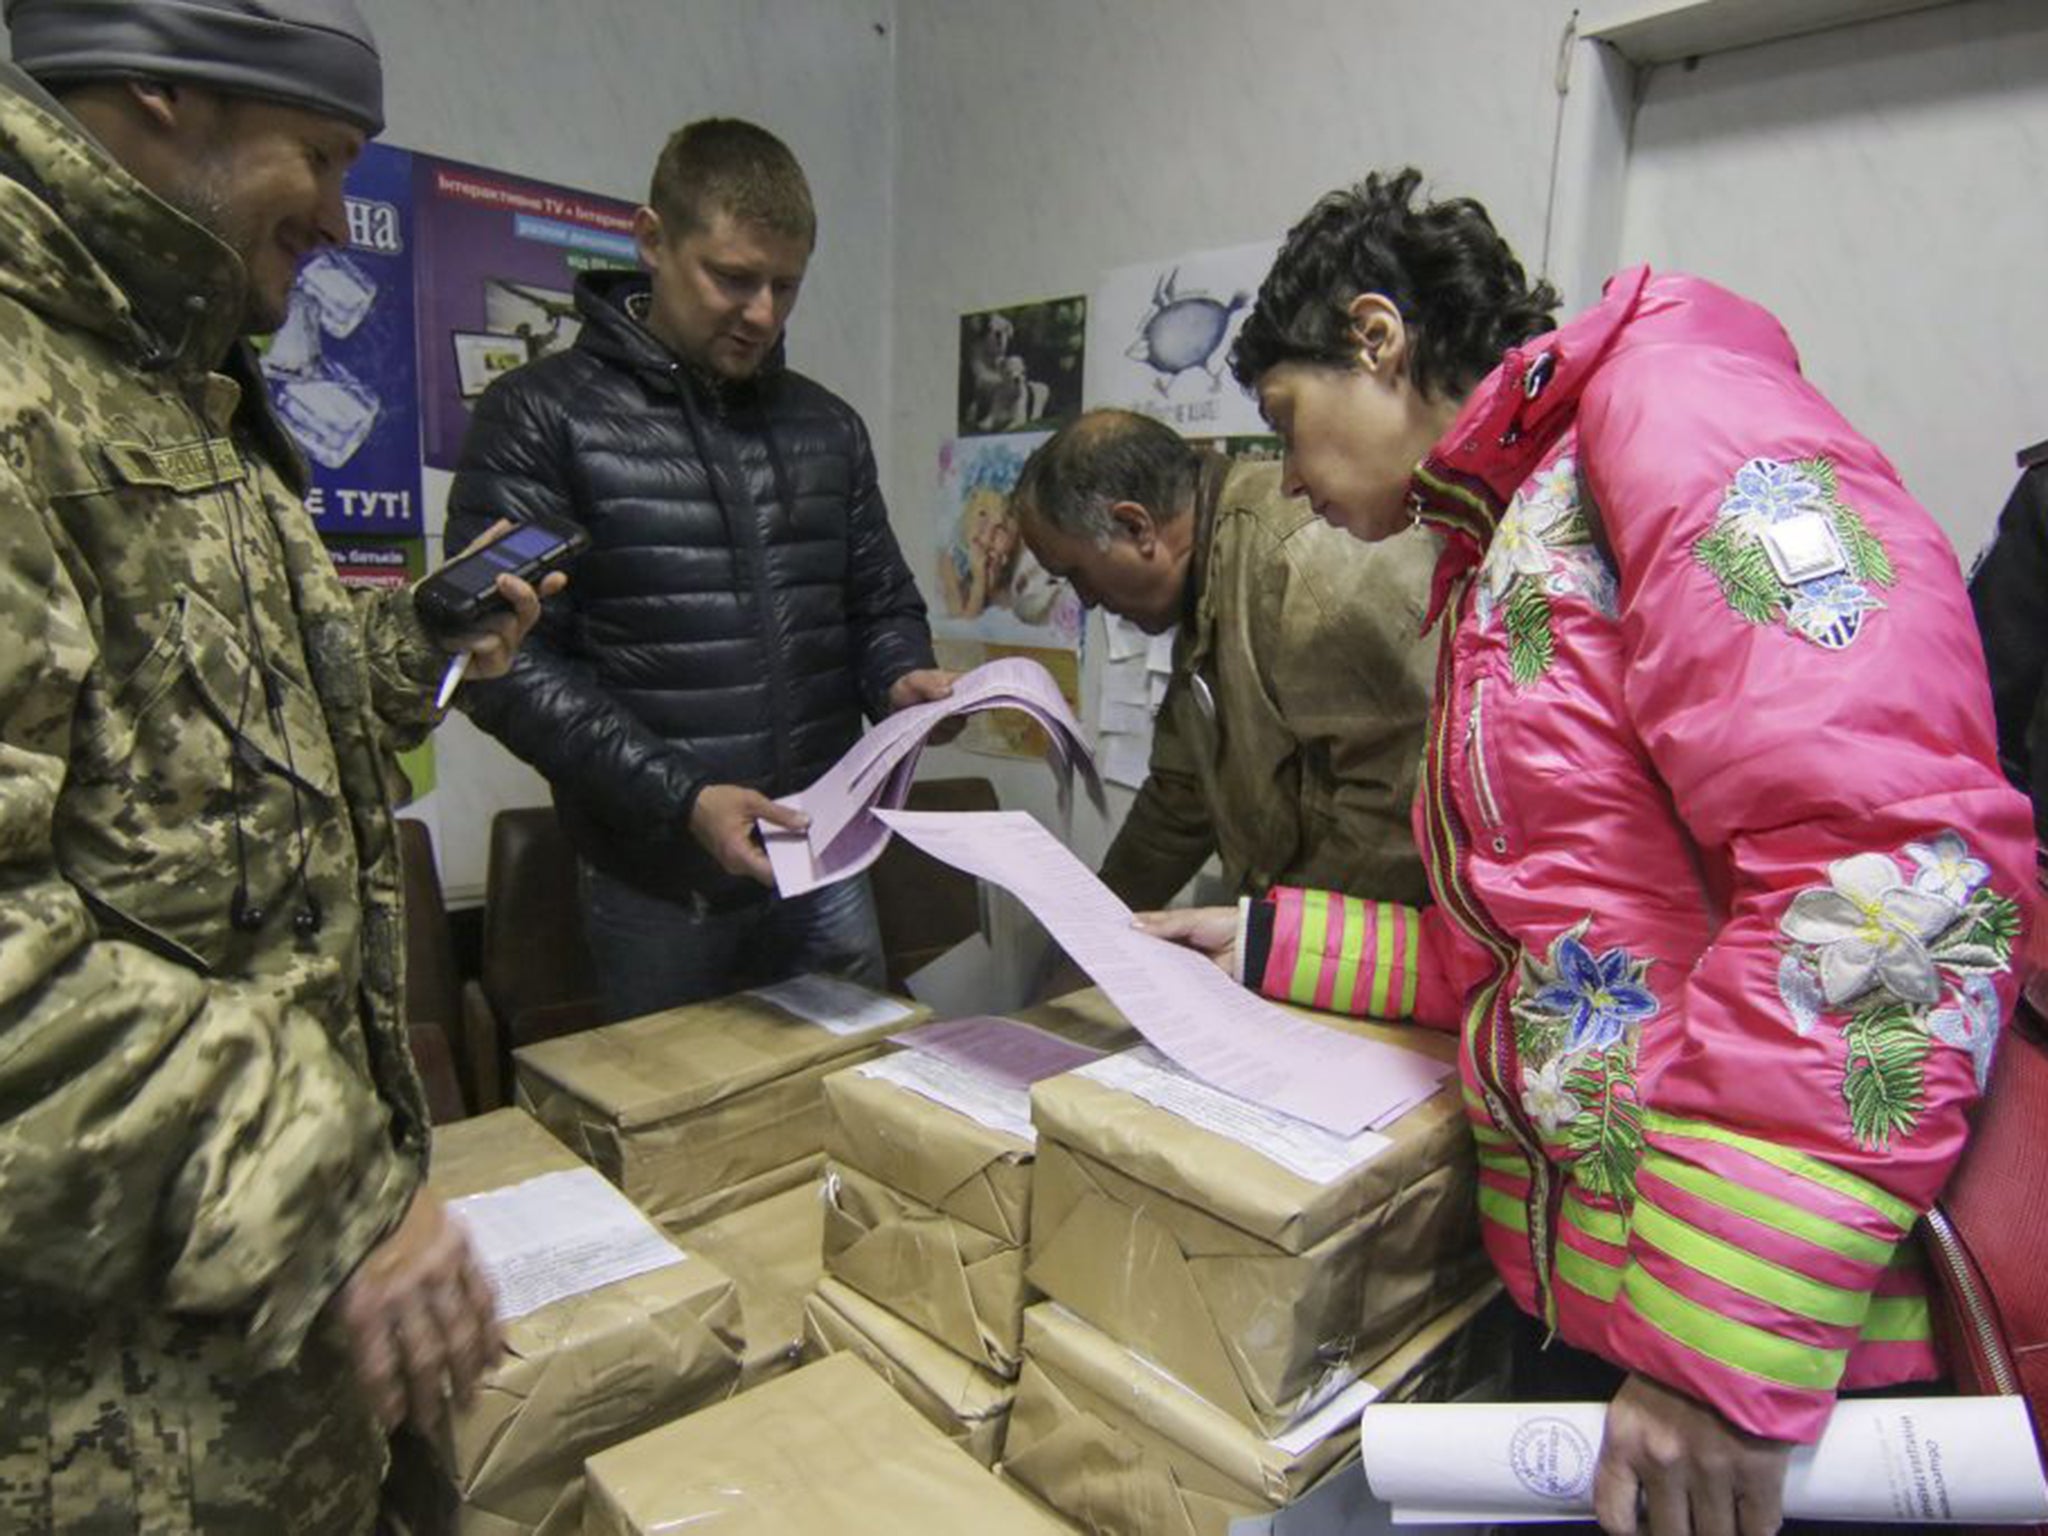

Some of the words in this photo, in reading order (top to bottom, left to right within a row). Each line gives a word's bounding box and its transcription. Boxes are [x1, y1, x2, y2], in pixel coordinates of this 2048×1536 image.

[543, 198, 565, 216] TV
[342, 198, 400, 252] на
[335, 489, 410, 519] ТУТ!
